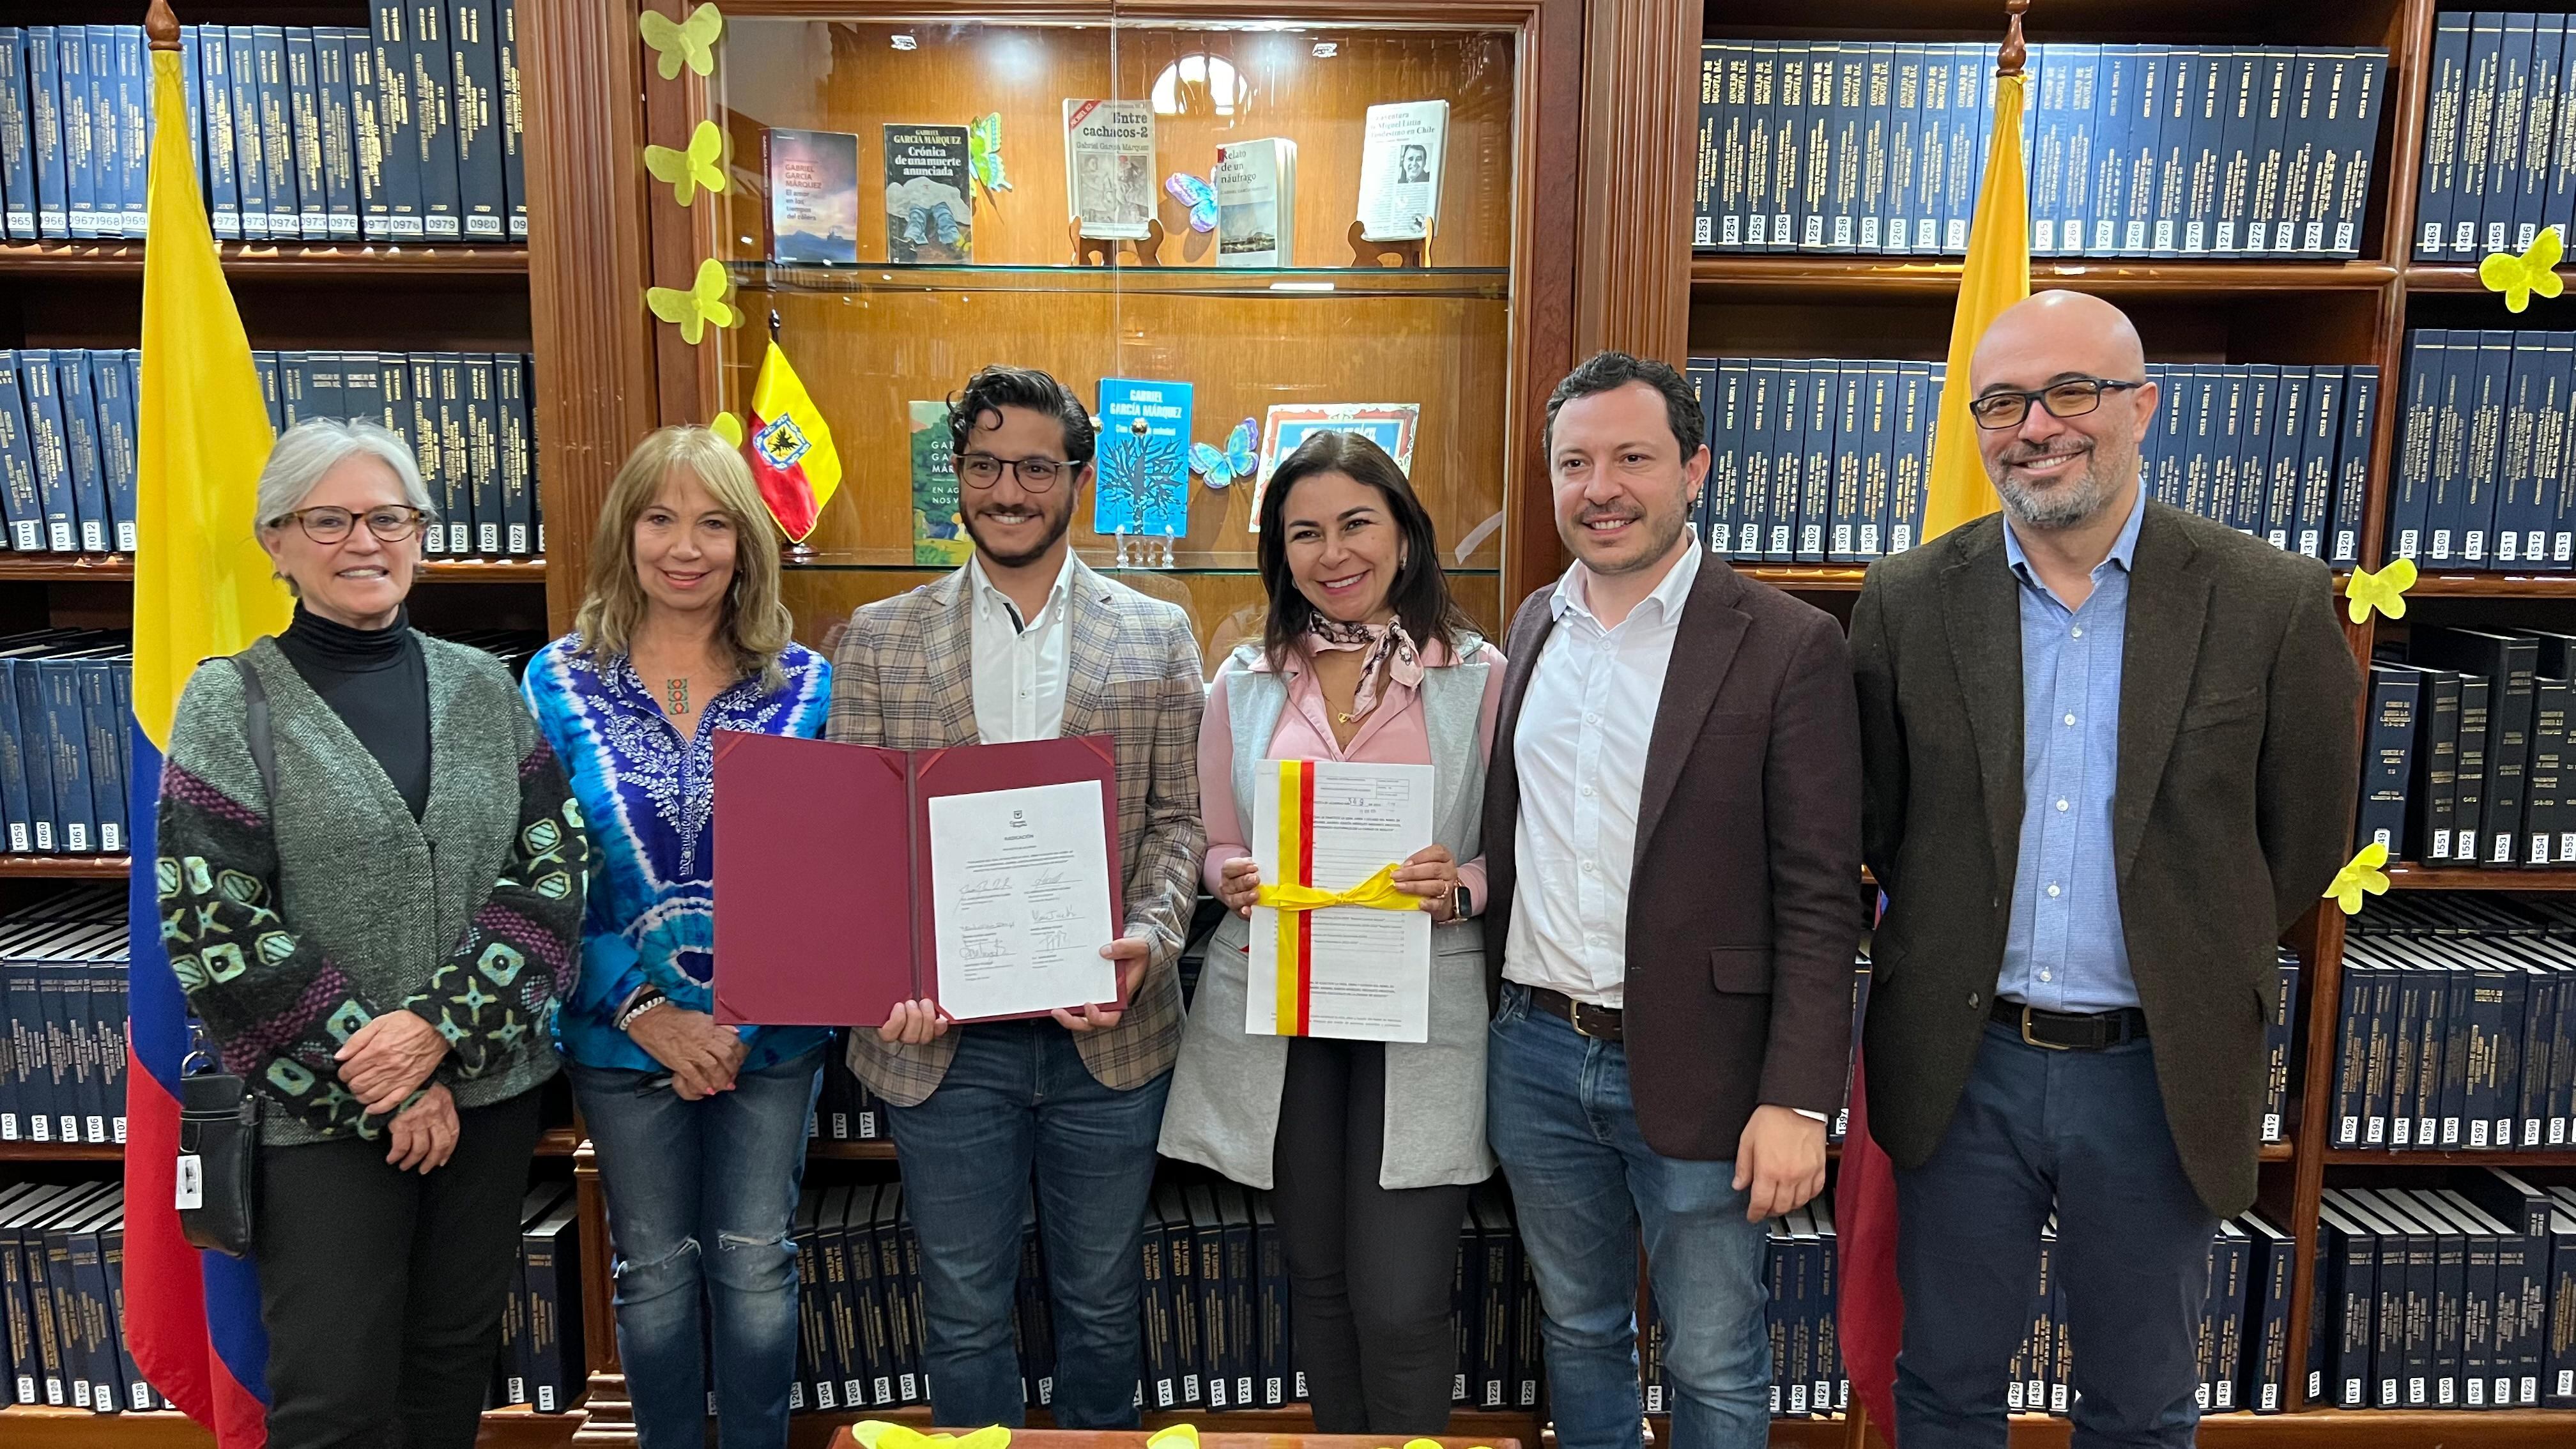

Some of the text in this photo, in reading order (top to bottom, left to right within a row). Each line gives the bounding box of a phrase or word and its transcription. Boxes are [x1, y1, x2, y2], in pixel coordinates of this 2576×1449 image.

[1114, 112, 1147, 124] Entre
[1083, 126, 1148, 138] cachacos-2
[1416, 126, 1435, 134] Chile
[895, 155, 962, 166] de una muerte
[908, 146, 946, 157] Crónica
[1223, 150, 1246, 160] Relato
[785, 164, 815, 172] GABRIEL
[903, 166, 954, 176] anunciada
[1221, 163, 1232, 172] de
[1221, 173, 1257, 183] náufrago
[270, 218, 298, 227] 0974
[331, 218, 356, 227] 0976
[393, 220, 420, 229] 0978
[429, 220, 456, 229] 0979
[470, 219, 497, 229] 0980
[1699, 218, 1708, 243] 1253
[1726, 218, 1735, 243] 1254
[1752, 217, 1761, 242] 1255
[1778, 217, 1787, 242] 1256
[1809, 218, 1818, 242] 1257
[1838, 219, 1847, 244] 1258
[1866, 220, 1874, 245] 1259
[1892, 222, 1902, 246] 1260
[1922, 222, 1931, 247] 1261
[1951, 223, 1961, 246] 1262
[2099, 224, 2109, 248] 1267
[2130, 224, 2140, 248] 1268
[2159, 224, 2168, 248] 1269
[2190, 224, 2199, 249] 1270
[2221, 226, 2230, 249] 1271
[2251, 225, 2261, 249] 1272
[2280, 225, 2290, 250] 1273
[2309, 226, 2319, 250] 1274
[2338, 225, 2349, 250] 1275
[2427, 226, 2437, 249] 1463
[2461, 225, 2470, 249] 1464
[2492, 225, 2500, 249] 1465
[1130, 390, 1163, 402] GABRIEL
[1110, 402, 1182, 419] GARCÍA MÁRQUEZ
[931, 464, 954, 473] MÁR
[21, 523, 30, 546] 1010
[56, 525, 66, 548] 1011
[87, 524, 96, 547] 1012
[122, 525, 132, 548] 1013
[455, 527, 463, 549] 1025
[485, 526, 493, 549] 1026
[513, 527, 522, 550] 1027
[1716, 526, 1725, 550] 1299
[1745, 526, 1754, 550] 1300
[1775, 528, 1784, 551] 1301
[1808, 528, 1816, 551] 1302
[1864, 527, 1873, 550] 1304
[1897, 528, 1906, 551] 1305
[2340, 533, 2349, 556] 1320
[2405, 533, 2414, 555] 1508
[2437, 533, 2446, 555] 1509
[2469, 533, 2479, 556] 1510
[2503, 535, 2512, 557] 1511
[2531, 535, 2540, 557] 1512
[2558, 535, 2567, 558] 1513
[13, 825, 23, 847] 1059
[73, 827, 82, 848] 1061
[105, 826, 114, 848] 1062
[2437, 834, 2446, 854] 1551
[2462, 835, 2471, 857] 1552
[2564, 836, 2573, 858] 1555
[2499, 838, 2507, 859] 1553
[2535, 839, 2543, 861] 1554
[35, 1118, 45, 1138] 1104
[65, 1118, 74, 1139] 1105
[90, 1119, 100, 1140] 1106
[117, 1119, 126, 1140] 1107
[862, 1114, 871, 1136] 1177
[2267, 1116, 2276, 1138] 1412
[2345, 1119, 2354, 1139] 1592
[2371, 1119, 2380, 1139] 1593
[2397, 1120, 2405, 1141] 1594
[2423, 1121, 2432, 1142] 1595
[2447, 1119, 2455, 1141] 1596
[2528, 1121, 2536, 1142] 1599
[2553, 1119, 2561, 1140] 1600
[542, 1388, 550, 1407] 1141
[822, 1384, 831, 1406] 1204
[848, 1382, 857, 1404] 1205
[878, 1379, 887, 1401] 1206
[903, 1376, 912, 1398] 1207
[1160, 1381, 1169, 1404] 1216
[1186, 1377, 1196, 1399] 1217
[1269, 1379, 1278, 1402] 1220
[1524, 1381, 1533, 1403] 1229
[1795, 1386, 1803, 1408] 1420
[2011, 1384, 2020, 1404] 1429
[2032, 1382, 2040, 1402] 1430
[2055, 1387, 2063, 1406] 1431
[2220, 1383, 2228, 1403] 1438
[2265, 1386, 2273, 1406] 1439
[1650, 1388, 1659, 1409] 1414
